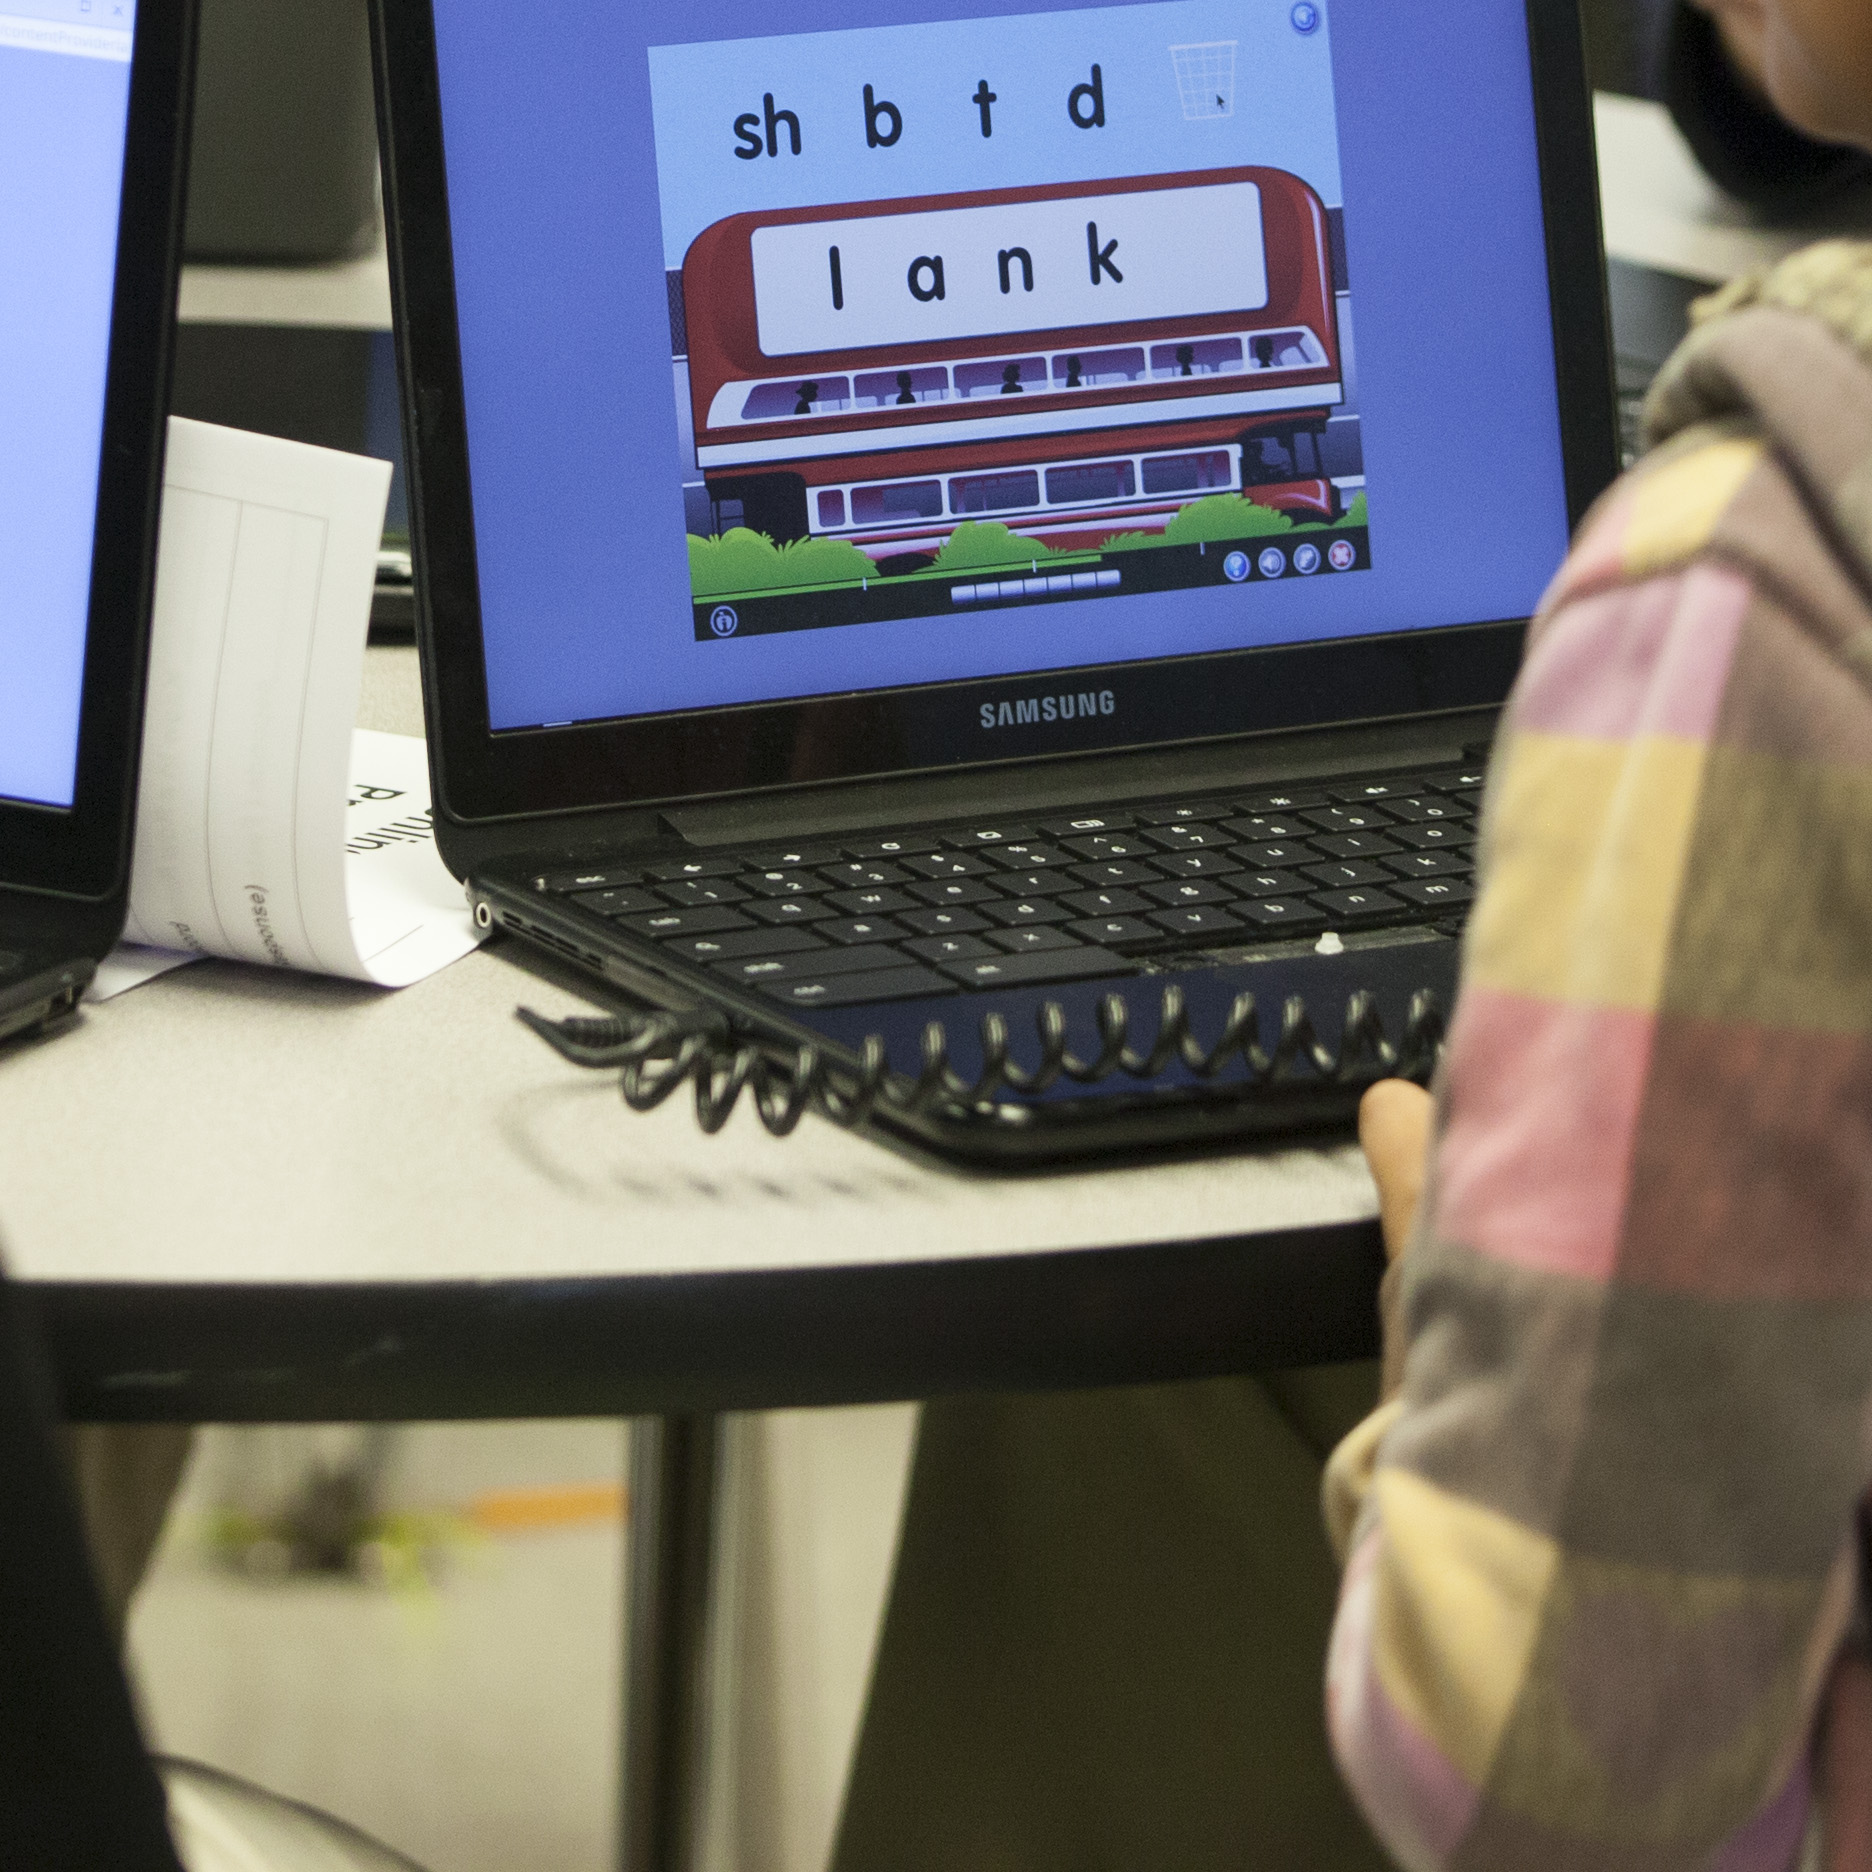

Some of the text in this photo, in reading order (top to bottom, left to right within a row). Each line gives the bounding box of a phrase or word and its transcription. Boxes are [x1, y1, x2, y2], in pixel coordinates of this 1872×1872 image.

[731, 61, 1108, 162] sh b t d
[978, 688, 1116, 730] SAMSUNG
